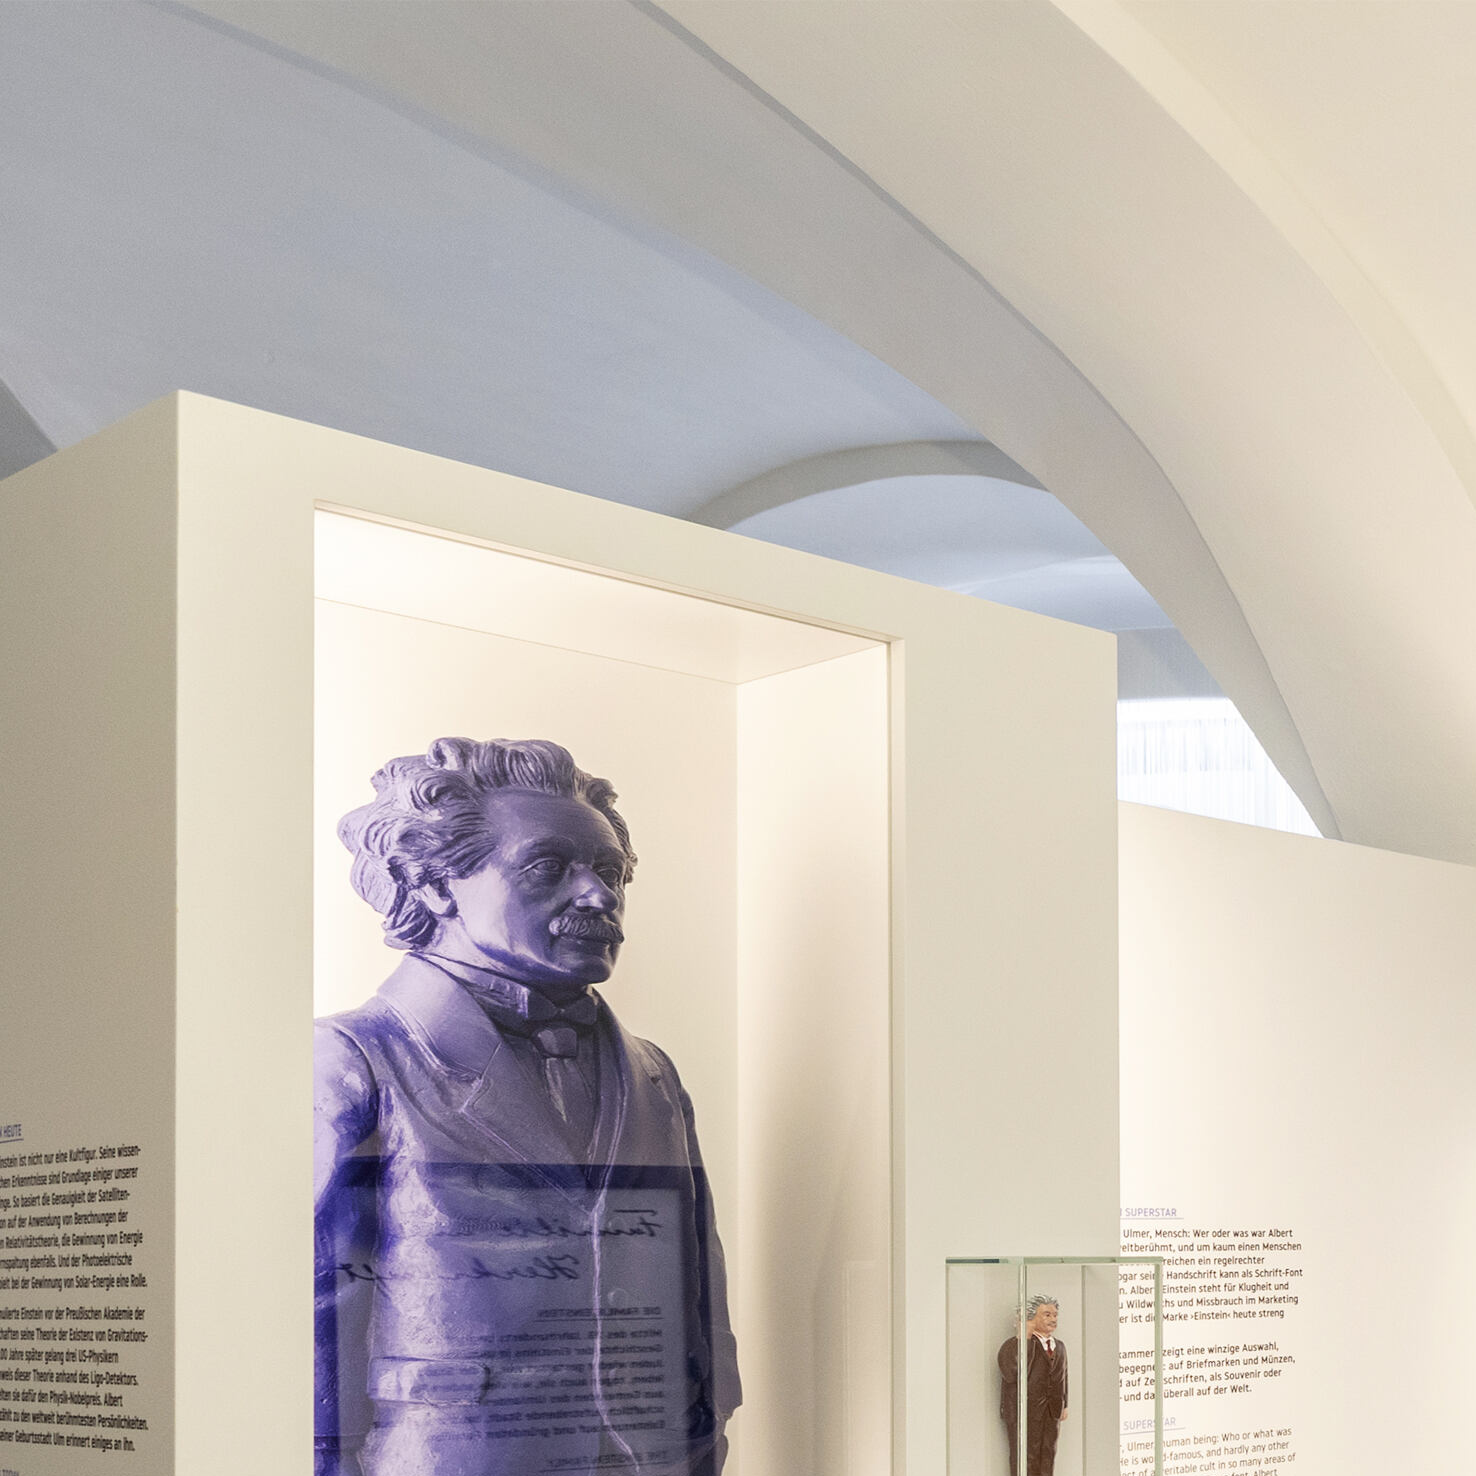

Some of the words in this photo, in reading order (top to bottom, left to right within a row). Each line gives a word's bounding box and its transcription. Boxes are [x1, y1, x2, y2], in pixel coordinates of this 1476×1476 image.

[28, 1151, 43, 1165] nicht
[44, 1153, 54, 1164] nur
[55, 1149, 68, 1163] eine
[69, 1147, 98, 1164] Kultfigur.
[99, 1145, 116, 1159] Seine
[117, 1143, 141, 1157] wissen-
[48, 1170, 60, 1184] sind
[61, 1169, 91, 1186] Grundlage
[92, 1167, 113, 1184] einiger
[114, 1168, 138, 1179] unserer
[1125, 1208, 1176, 1217] SUPERSTAR
[1123, 1228, 1152, 1240] Ulmer,
[1154, 1228, 1190, 1238] Mensch:
[1193, 1228, 1208, 1238] Wer
[1212, 1228, 1230, 1238] oder
[1232, 1230, 1248, 1238] was
[1267, 1227, 1293, 1237] Albert
[1177, 1241, 1193, 1251] und
[1196, 1243, 1210, 1251] um
[1212, 1241, 1235, 1251] kaum
[1237, 1240, 1260, 1251] einen
[1262, 1240, 1302, 1250] Menschen
[1166, 1268, 1216, 1280] Handschrift
[1218, 1268, 1239, 1278] kann
[1241, 1267, 1252, 1278] als
[1254, 1267, 1303, 1277] Schrift-Font
[1162, 1282, 1196, 1293] Einstein
[1198, 1281, 1221, 1292] steht
[1223, 1281, 1236, 1291] für
[1238, 1280, 1271, 1294] Klugheit
[1274, 1280, 1288, 1290] und
[1177, 1296, 1193, 1307] und
[1196, 1295, 1242, 1307] Missbrauch
[1245, 1295, 1255, 1305] im
[1258, 1294, 1298, 1307] Marketing
[20, 1306, 44, 1320] Einstein
[44, 1310, 54, 1320] vor
[54, 1306, 65, 1320] der
[66, 1306, 102, 1320] Preußischen
[103, 1306, 133, 1320] Akademie
[134, 1306, 146, 1320] der
[1162, 1346, 1184, 1359] zeigt
[1186, 1345, 1204, 1356] eine
[1207, 1343, 1239, 1357] winzige
[1241, 1341, 1279, 1353] Auswahl,
